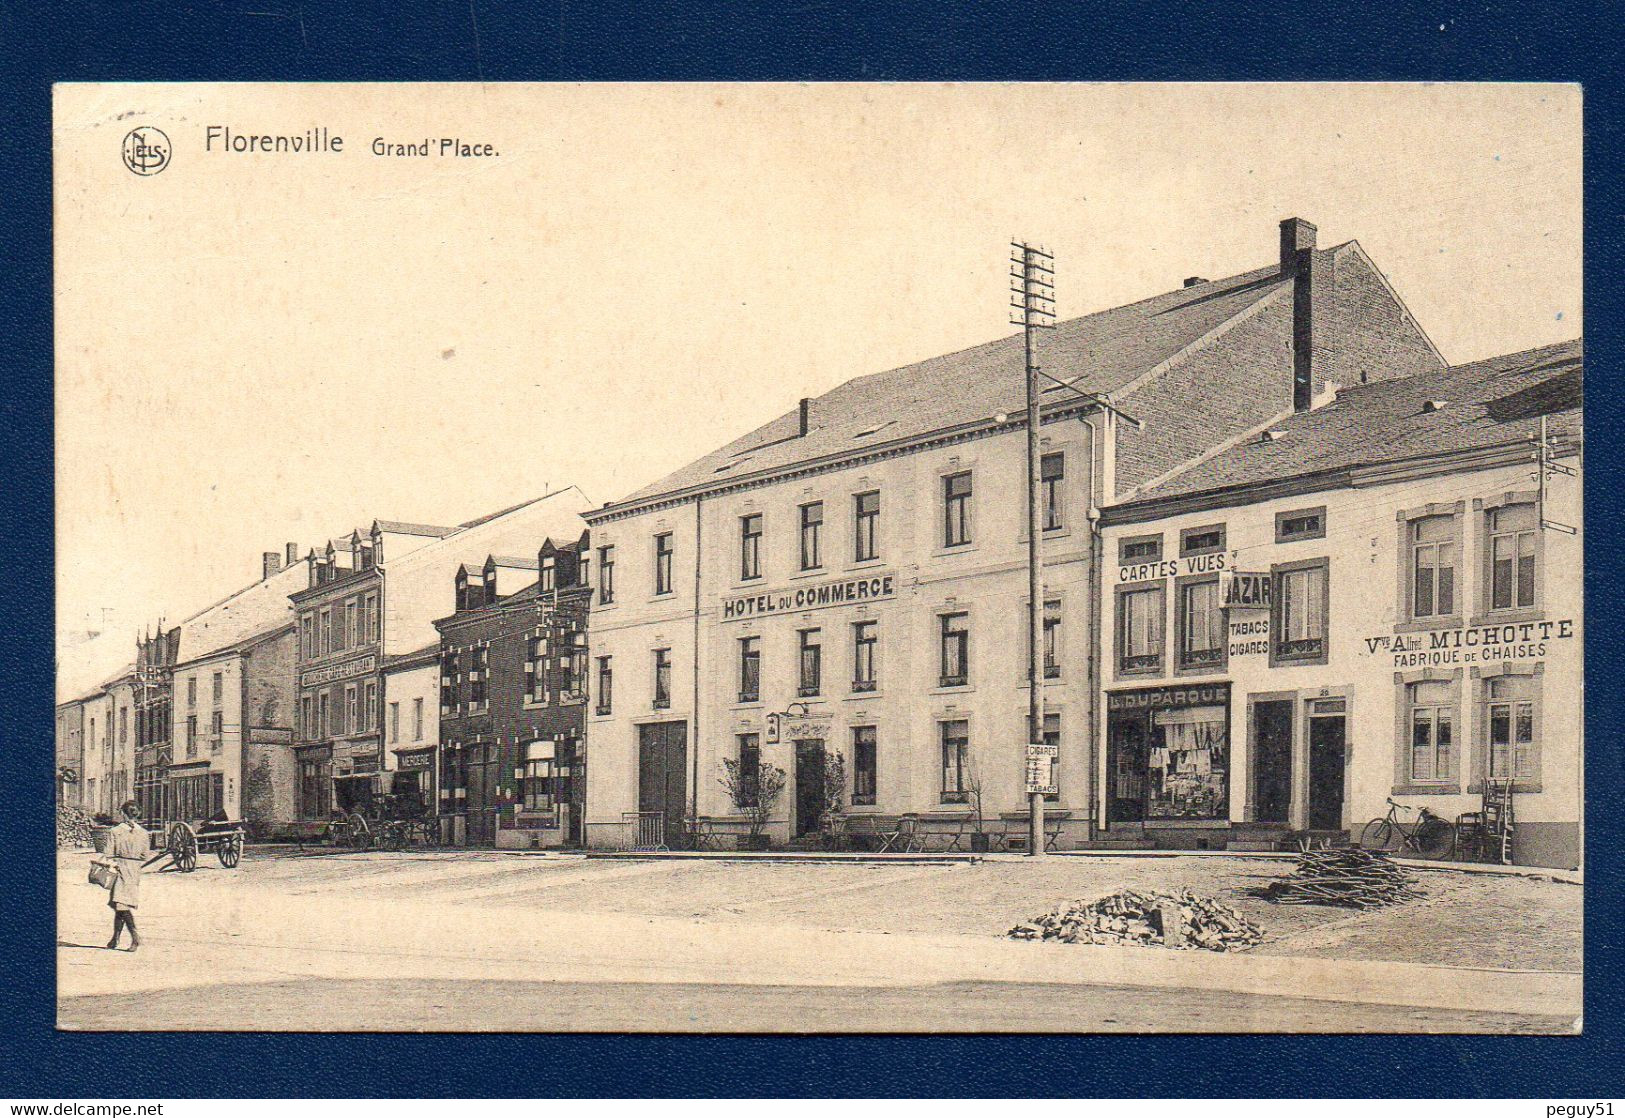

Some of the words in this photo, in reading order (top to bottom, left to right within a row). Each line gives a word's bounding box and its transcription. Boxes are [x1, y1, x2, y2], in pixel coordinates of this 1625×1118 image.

[1120, 560, 1177, 582] CARTES
[1187, 553, 1225, 574] VUES
[724, 594, 775, 618] HOTEL
[779, 596, 792, 610] DU
[795, 577, 893, 607] COMMERCE
[1230, 620, 1268, 637] TABACS
[1429, 619, 1573, 650] MICHOTTE
[1230, 641, 1268, 656] CIGARES
[1394, 651, 1460, 668] FABRIQUE
[1464, 652, 1477, 662] DE
[1482, 643, 1546, 662] CHAISES
[1125, 688, 1226, 707] DUPARQUE
[1029, 746, 1056, 756] CIGARES
